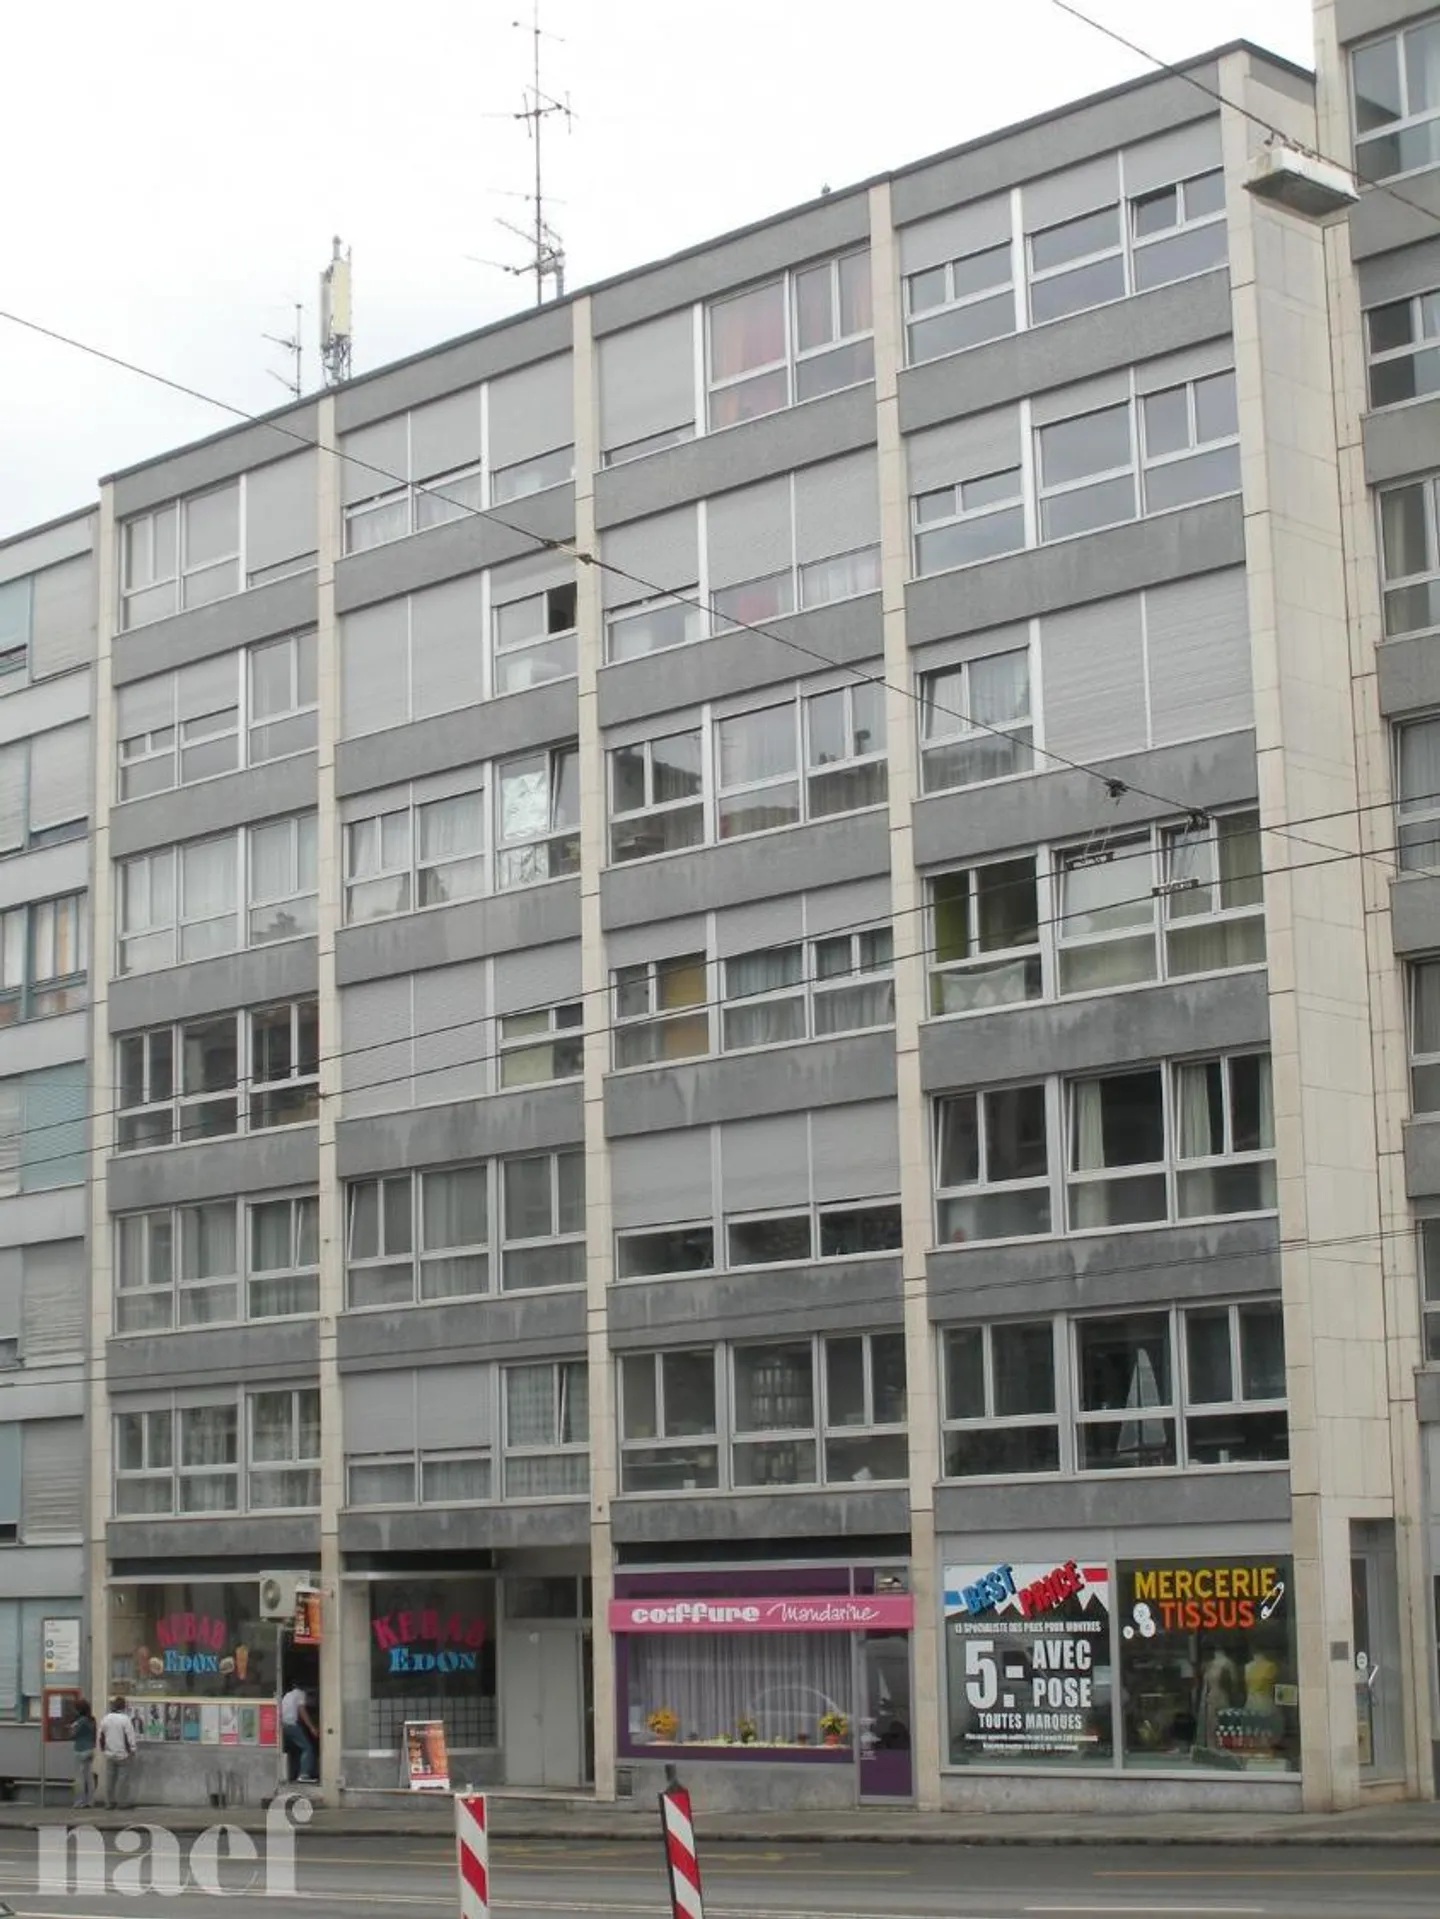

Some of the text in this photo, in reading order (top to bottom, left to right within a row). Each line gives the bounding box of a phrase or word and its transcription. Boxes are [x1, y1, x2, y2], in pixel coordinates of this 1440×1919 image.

[961, 1559, 1085, 1620] BEST PRICE
[1134, 1567, 1276, 1600] MERCERIE
[631, 1603, 880, 1624] coiffure Mandarine
[1159, 1600, 1255, 1629] TISSUS
[156, 1612, 227, 1648] KEBAB
[371, 1609, 486, 1650] KEBAB
[1032, 1639, 1092, 1670] AVEC
[1032, 1677, 1092, 1708] POSE
[978, 1712, 1082, 1731] TOUTES MARQUES
